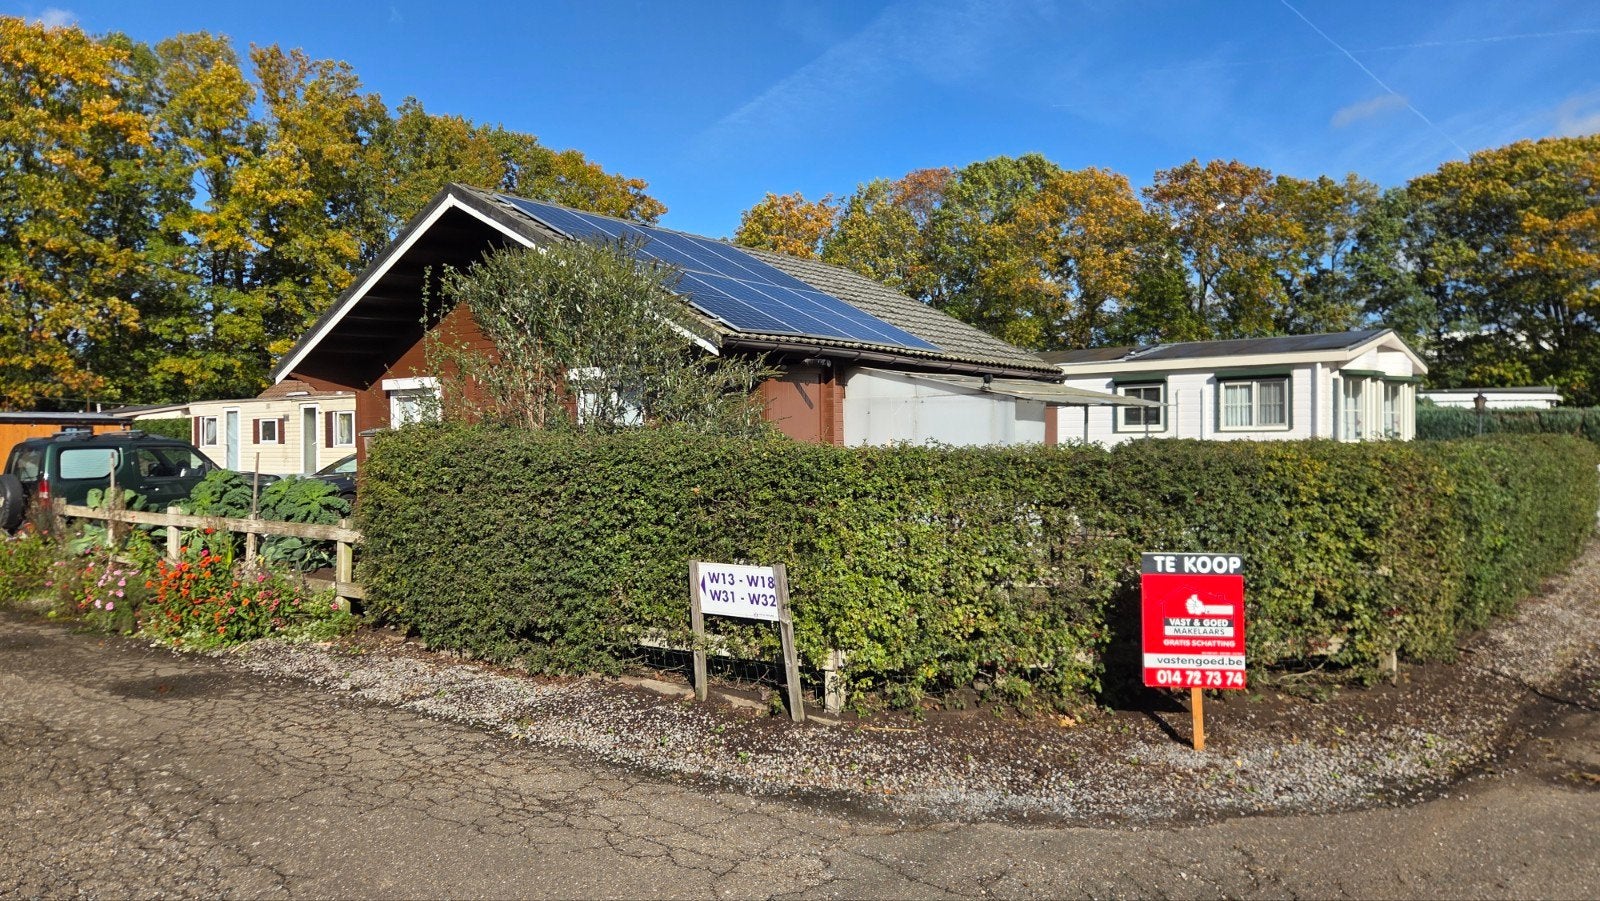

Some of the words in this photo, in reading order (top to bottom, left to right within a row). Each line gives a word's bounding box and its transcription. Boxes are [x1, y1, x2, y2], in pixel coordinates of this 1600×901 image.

[1154, 556, 1176, 572] TE
[1184, 556, 1240, 573] KOOP
[708, 572, 734, 585] W13
[747, 575, 775, 588] W18
[710, 590, 735, 603] W31
[748, 593, 776, 607] W32
[1169, 618, 1191, 626] VAST
[1193, 618, 1201, 627] &
[1163, 639, 1190, 647] GRATIS
[1157, 657, 1242, 666] vastengoed.be
[1157, 670, 1181, 683] 014
[1186, 670, 1202, 685] 72
[1206, 671, 1222, 686] 73
[1226, 672, 1243, 685] 74
